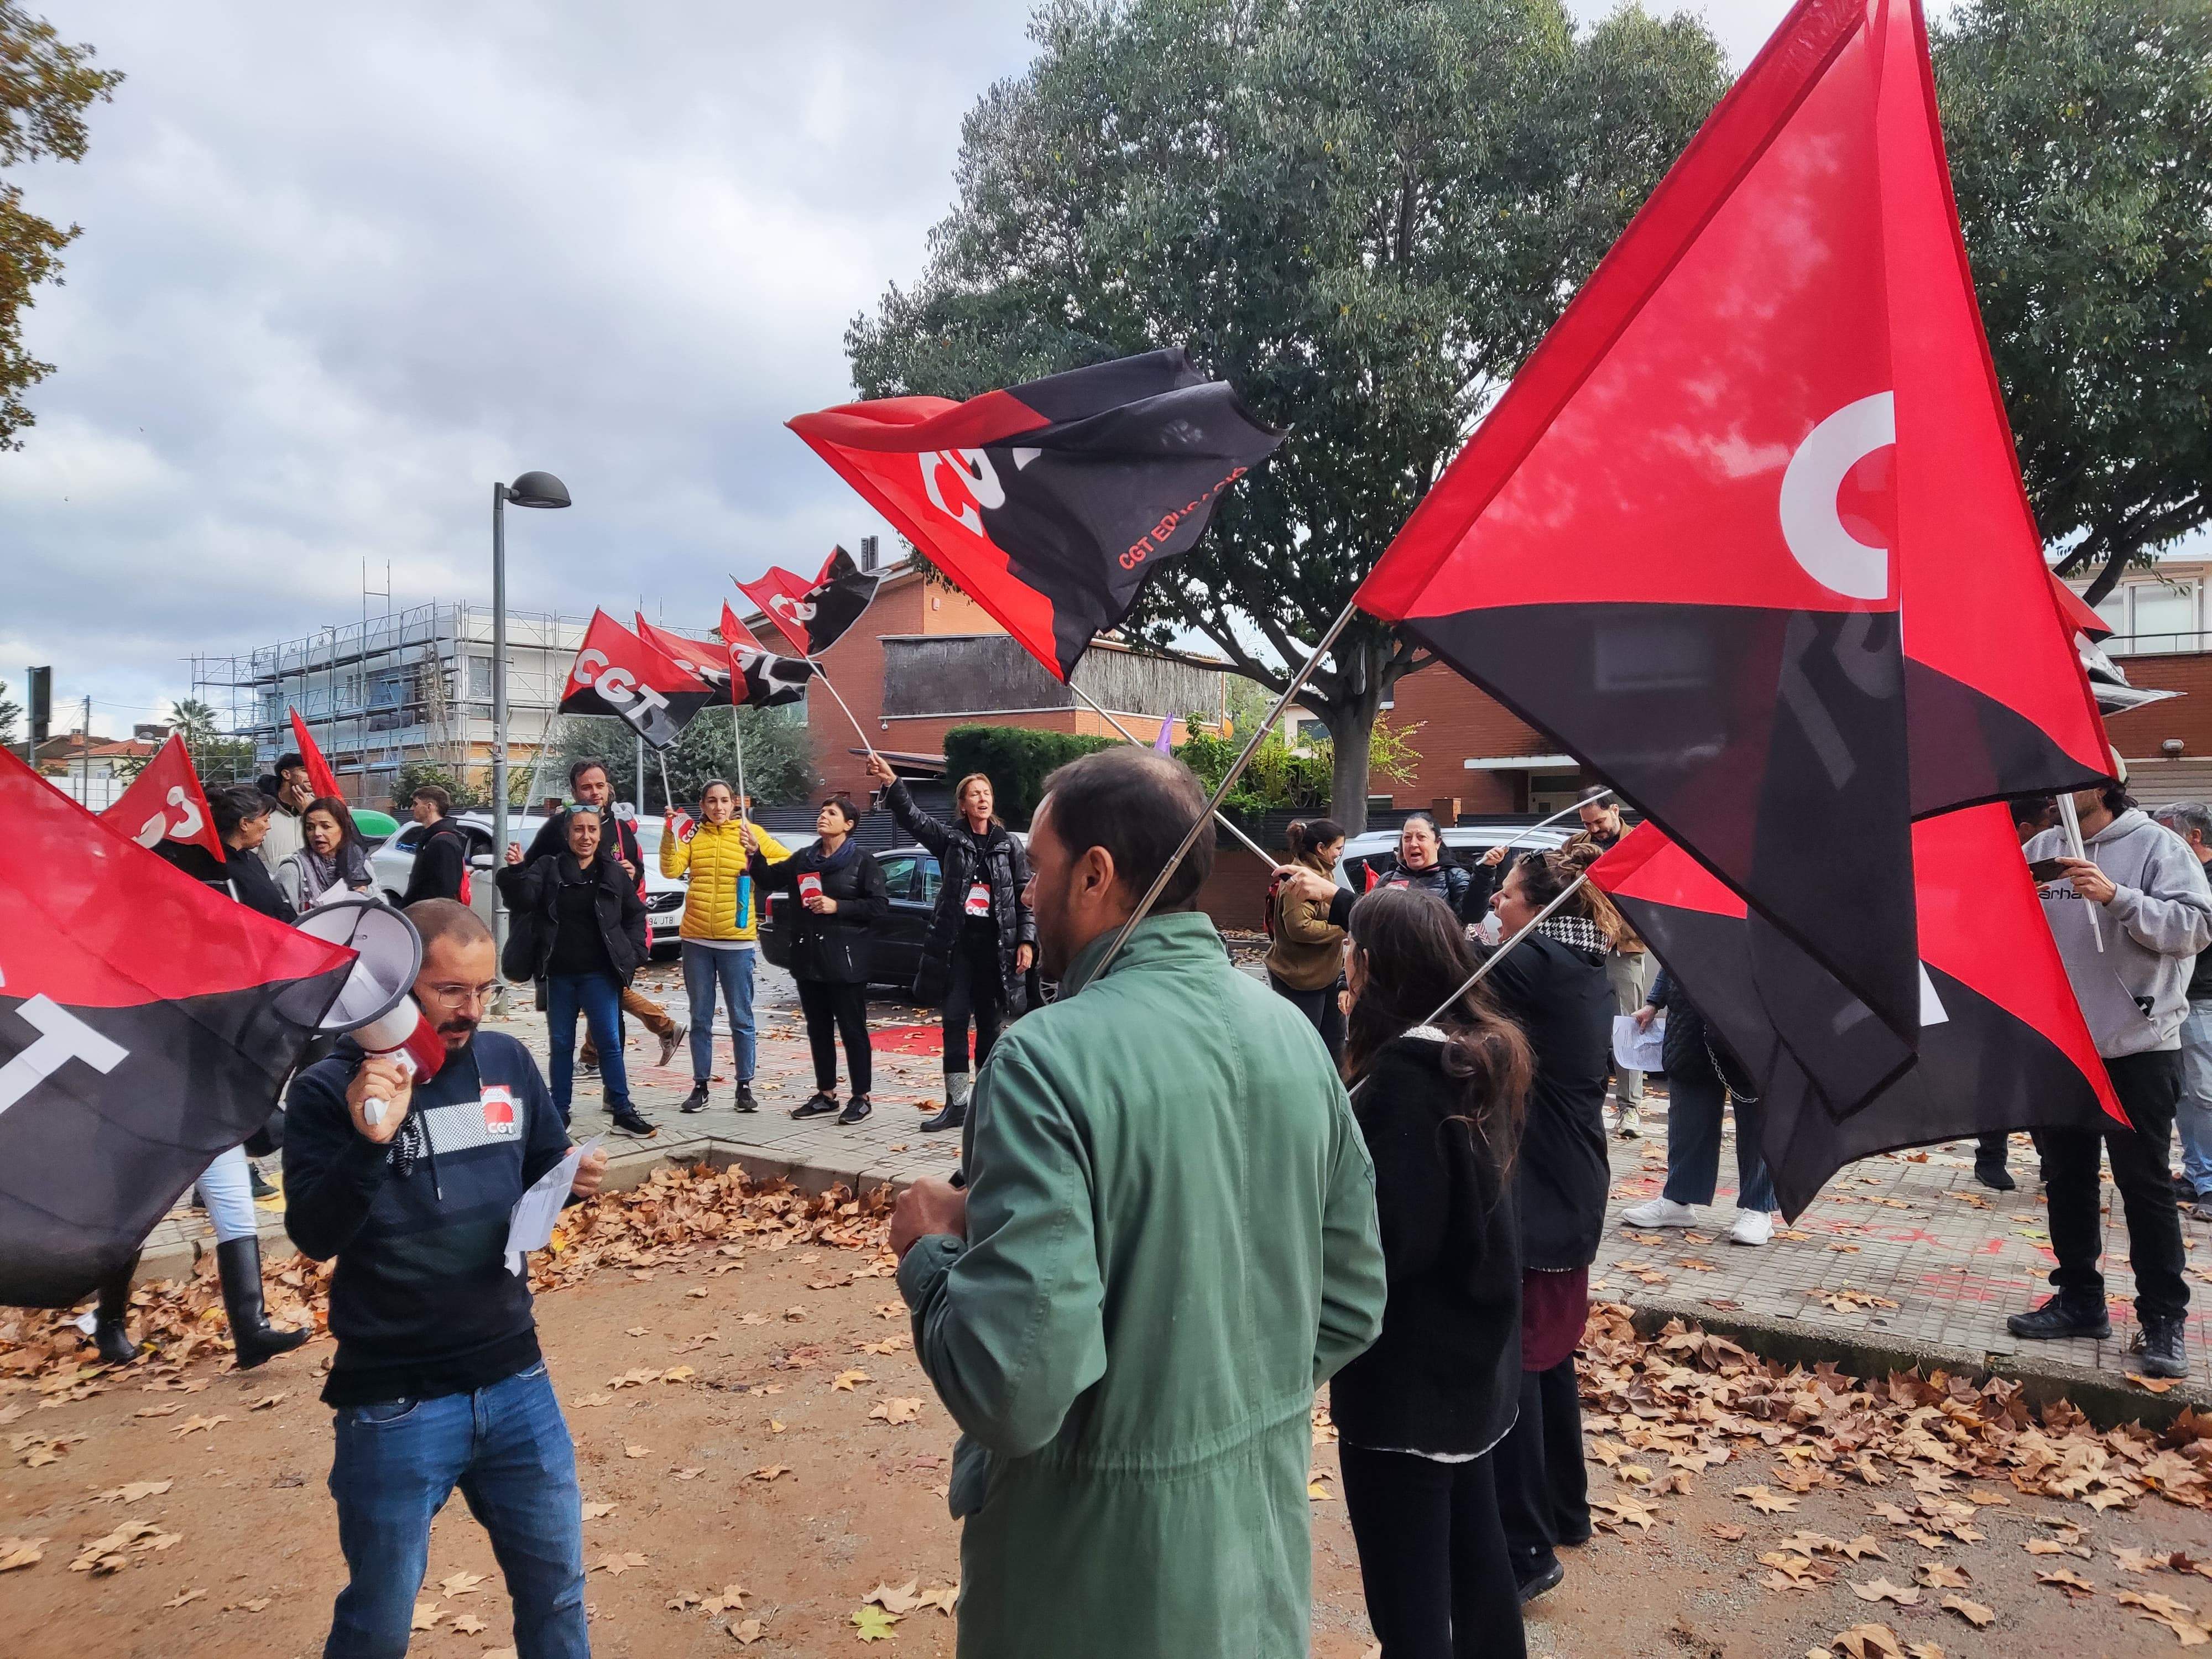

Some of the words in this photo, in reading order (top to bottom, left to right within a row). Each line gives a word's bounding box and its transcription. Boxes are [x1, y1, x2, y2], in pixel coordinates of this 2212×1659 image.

[1119, 536, 1155, 570] CGT
[573, 648, 670, 719] CGT
[681, 822, 698, 843] CGT
[966, 906, 989, 917] CGT
[649, 917, 658, 926] 94
[660, 916, 674, 925] JTB
[488, 1122, 515, 1134] CGT
